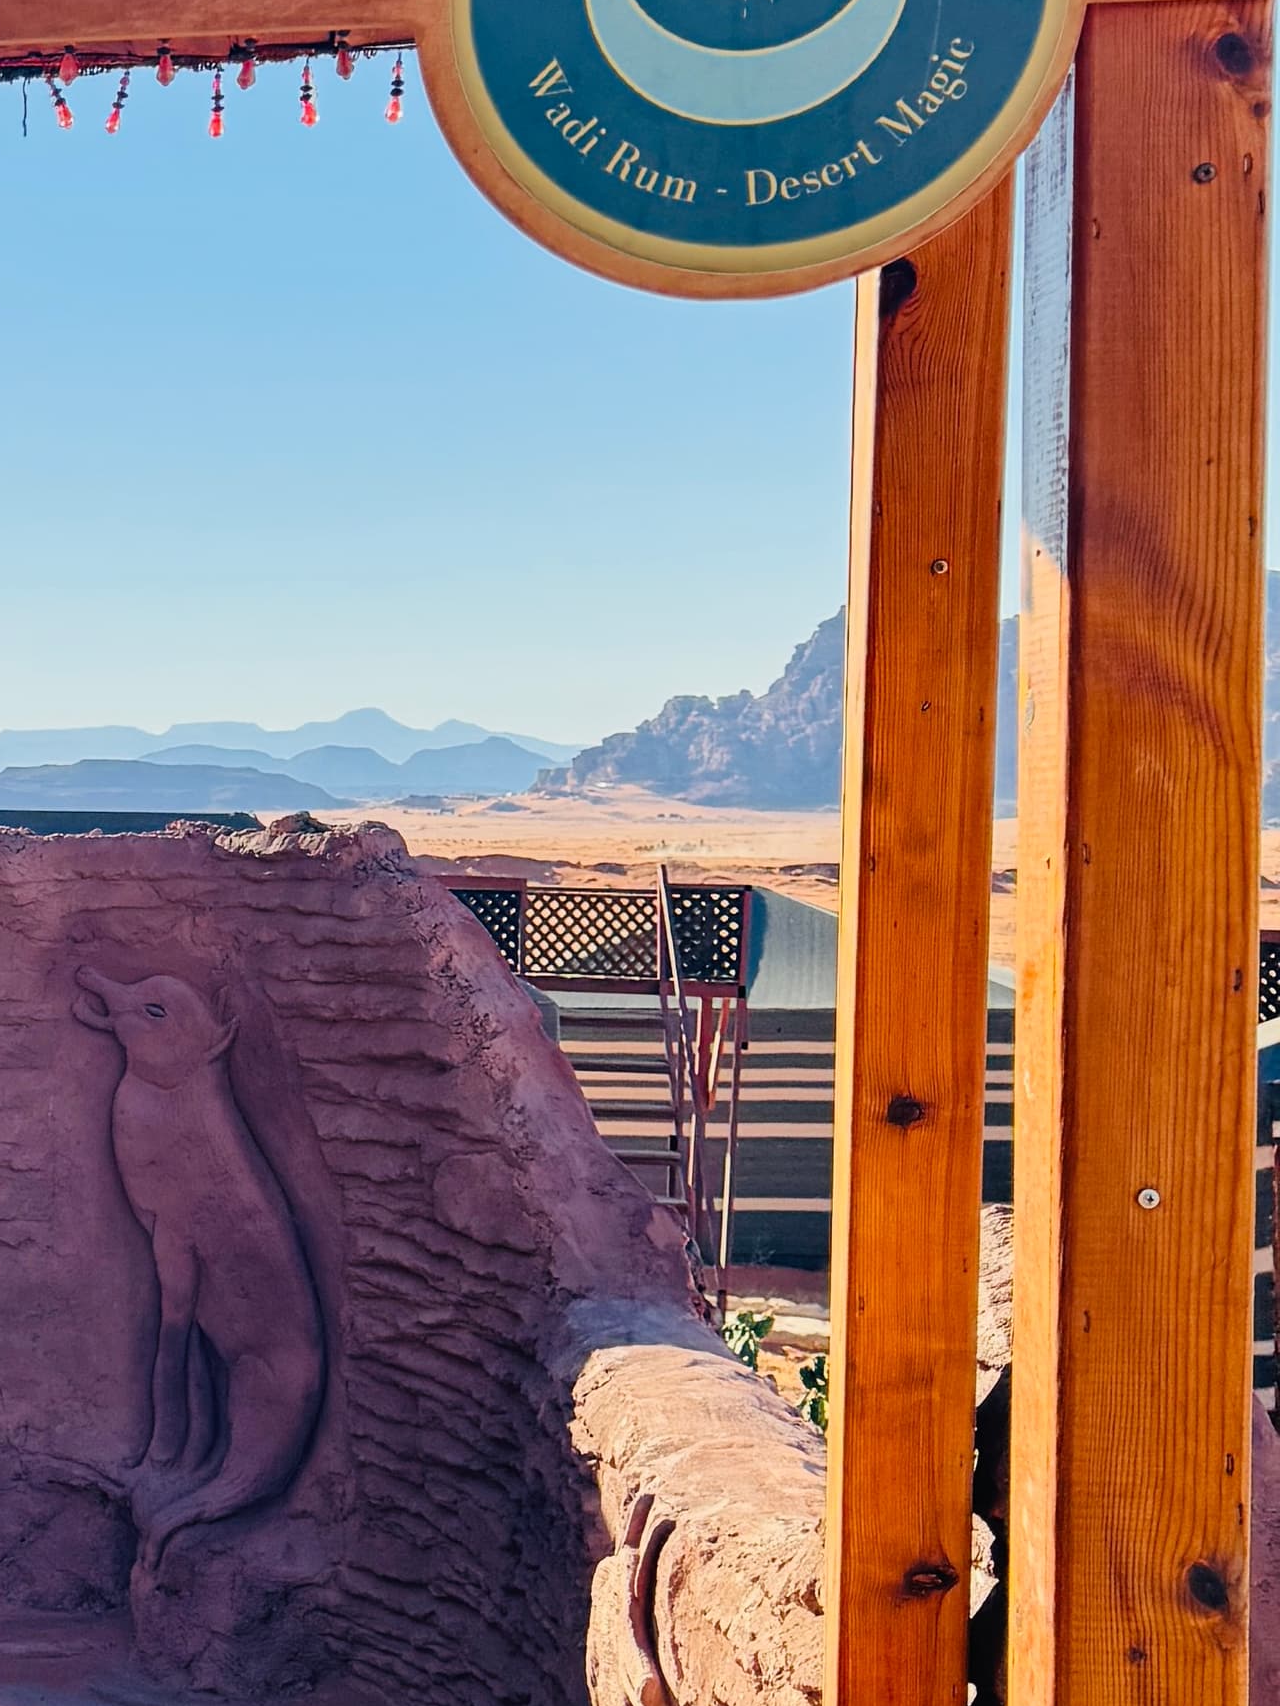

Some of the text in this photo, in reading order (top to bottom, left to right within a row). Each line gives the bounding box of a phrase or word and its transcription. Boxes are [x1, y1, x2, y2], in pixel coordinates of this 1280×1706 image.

[528, 56, 608, 157] Wadi
[603, 140, 698, 203] Rum
[744, 139, 883, 207] Desert
[873, 36, 976, 148] Magic
